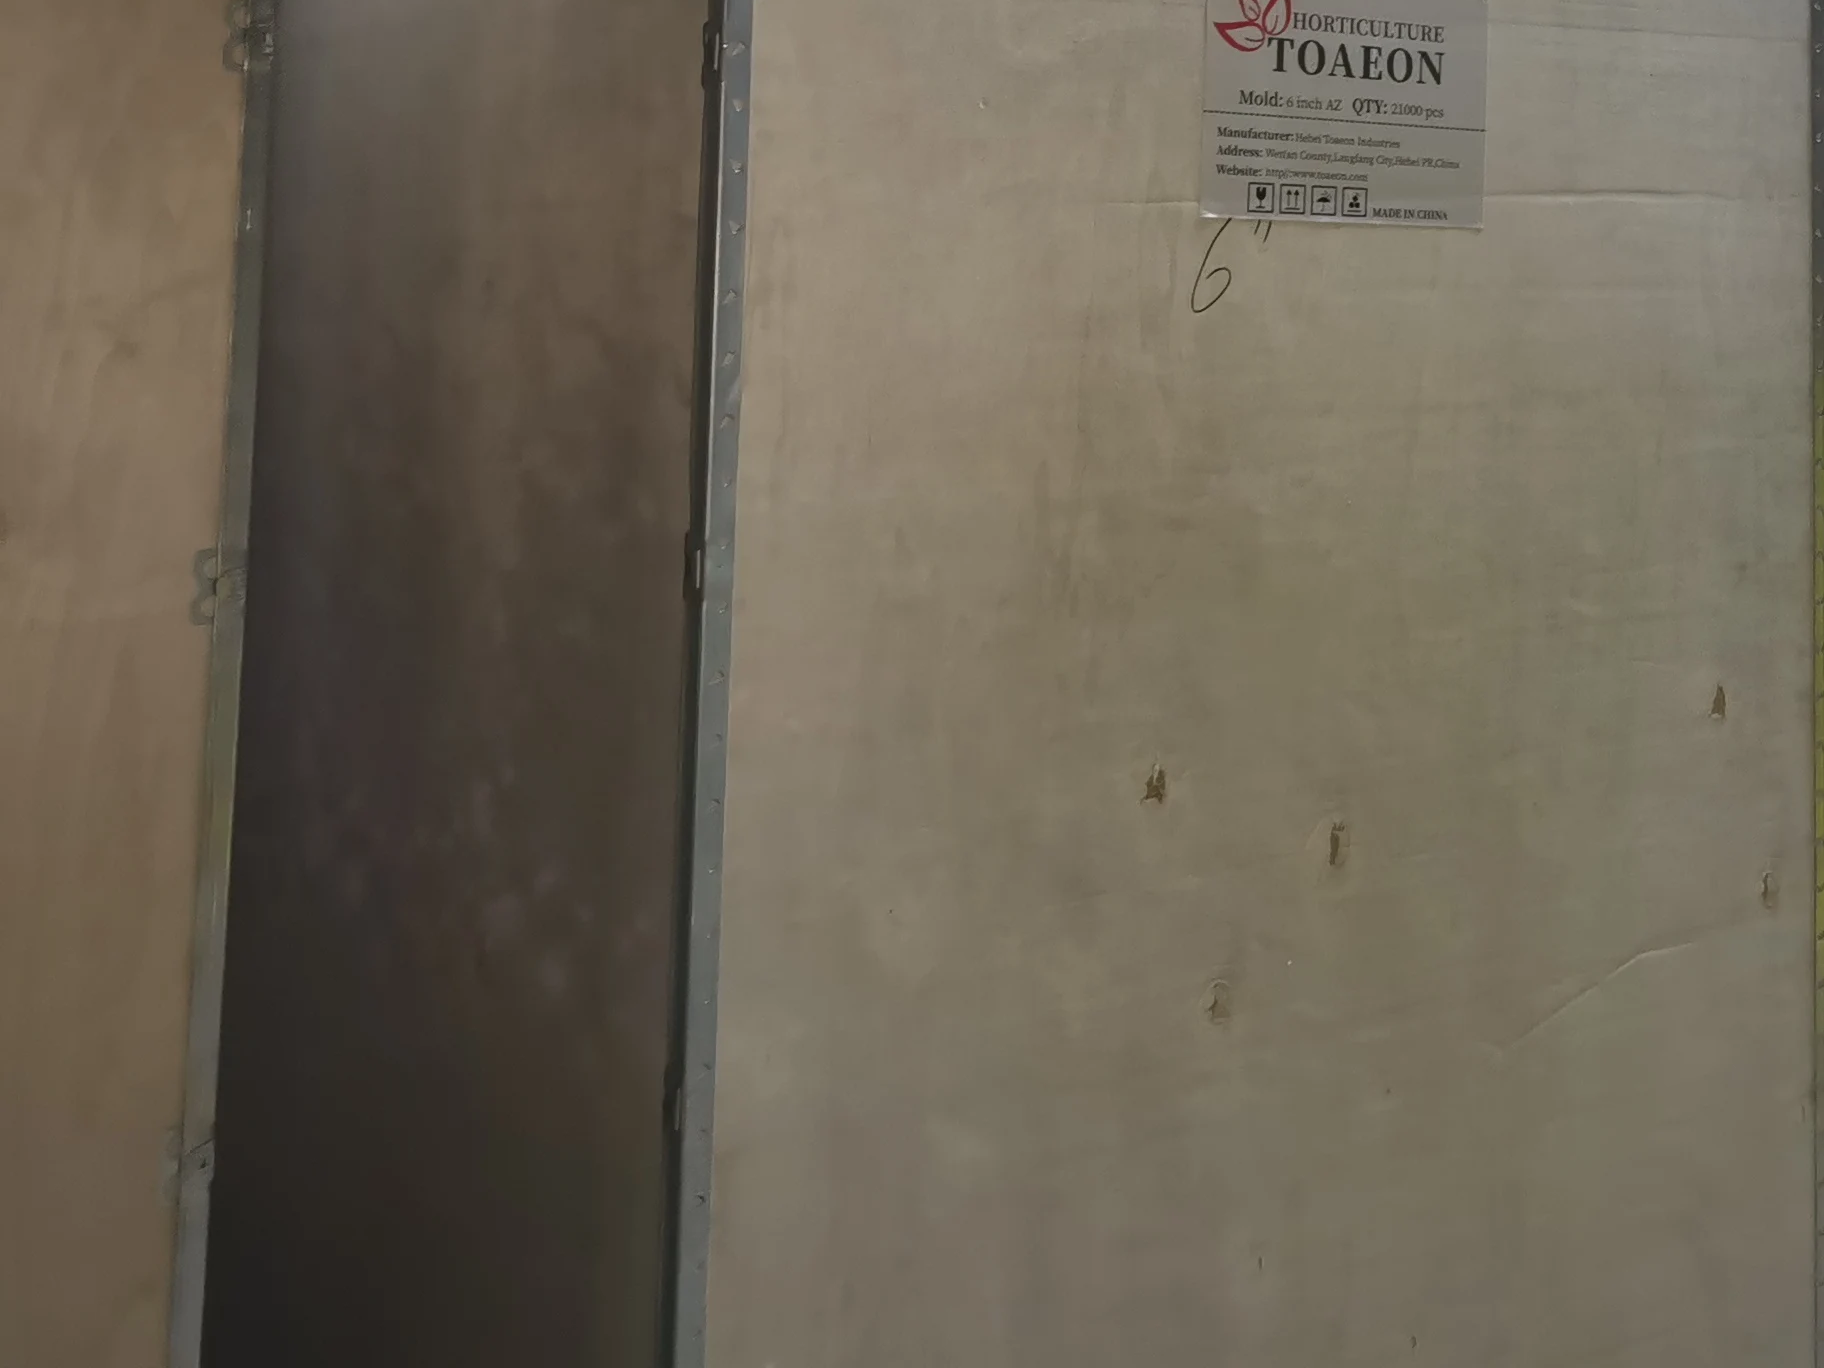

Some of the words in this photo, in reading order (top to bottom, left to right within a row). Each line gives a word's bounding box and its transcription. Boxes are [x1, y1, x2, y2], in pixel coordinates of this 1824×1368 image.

[1293, 12, 1445, 44] HORTICULTURE
[1267, 37, 1445, 85] TOAEON
[1238, 90, 1284, 108] Mold:
[1286, 96, 1294, 108] 6
[1296, 95, 1323, 110] inch
[1325, 98, 1343, 111] AZ
[1352, 98, 1389, 116] QTY:
[1424, 105, 1444, 120] pcs
[1216, 126, 1294, 142] Manufacturer:
[1216, 144, 1263, 159] Address:
[1216, 164, 1262, 178] Website:
[1372, 207, 1401, 219] MADE
[1402, 208, 1415, 219] IN
[1416, 209, 1449, 220] CHINA
